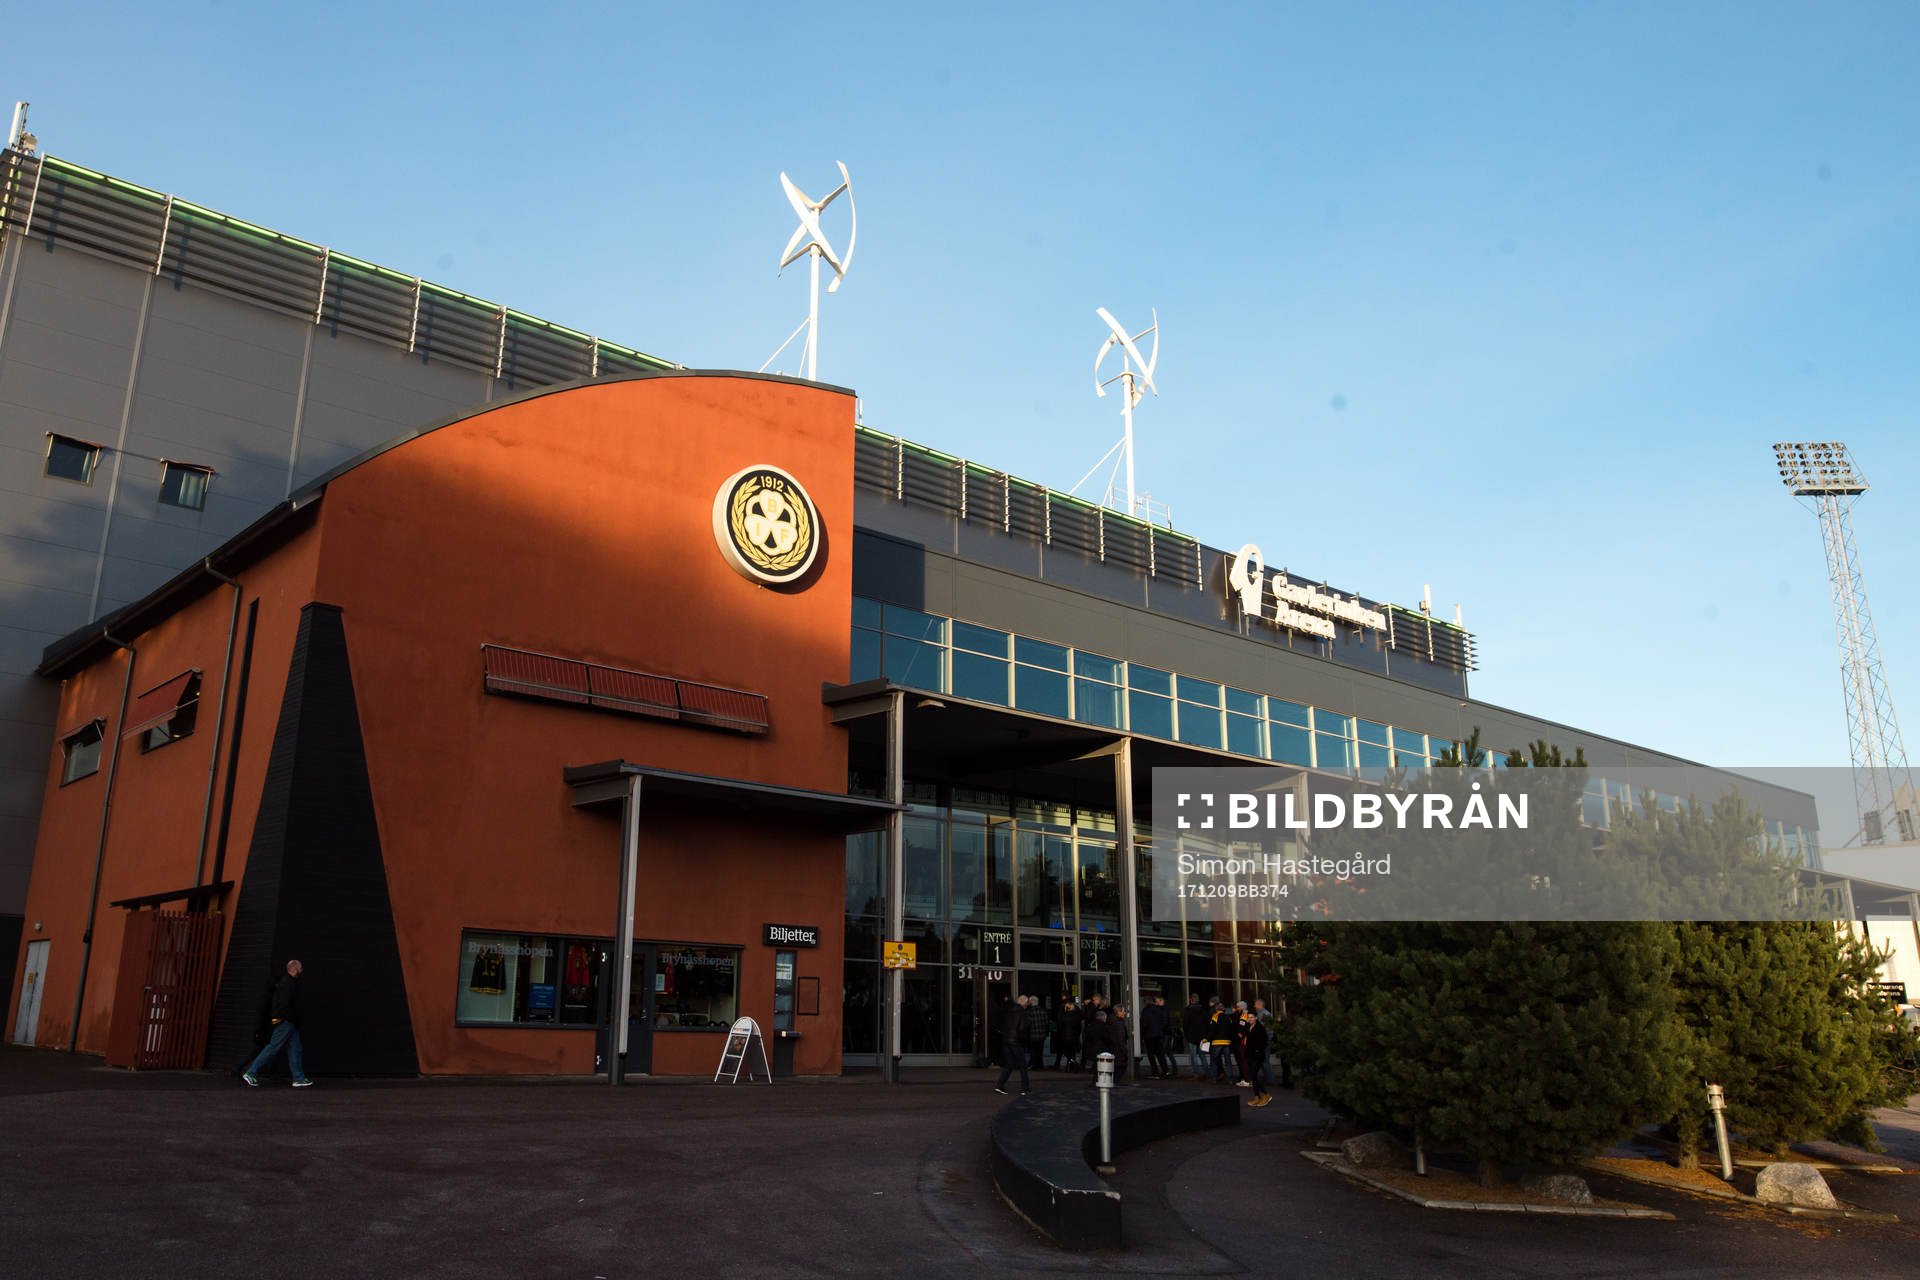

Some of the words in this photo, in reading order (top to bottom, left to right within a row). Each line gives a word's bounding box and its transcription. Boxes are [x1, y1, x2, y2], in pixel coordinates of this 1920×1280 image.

[760, 476, 784, 492] 1912
[769, 926, 815, 943] Biljetter
[983, 931, 1012, 944] ENTRÉ
[994, 946, 1001, 964] 1
[1089, 952, 1098, 969] 2
